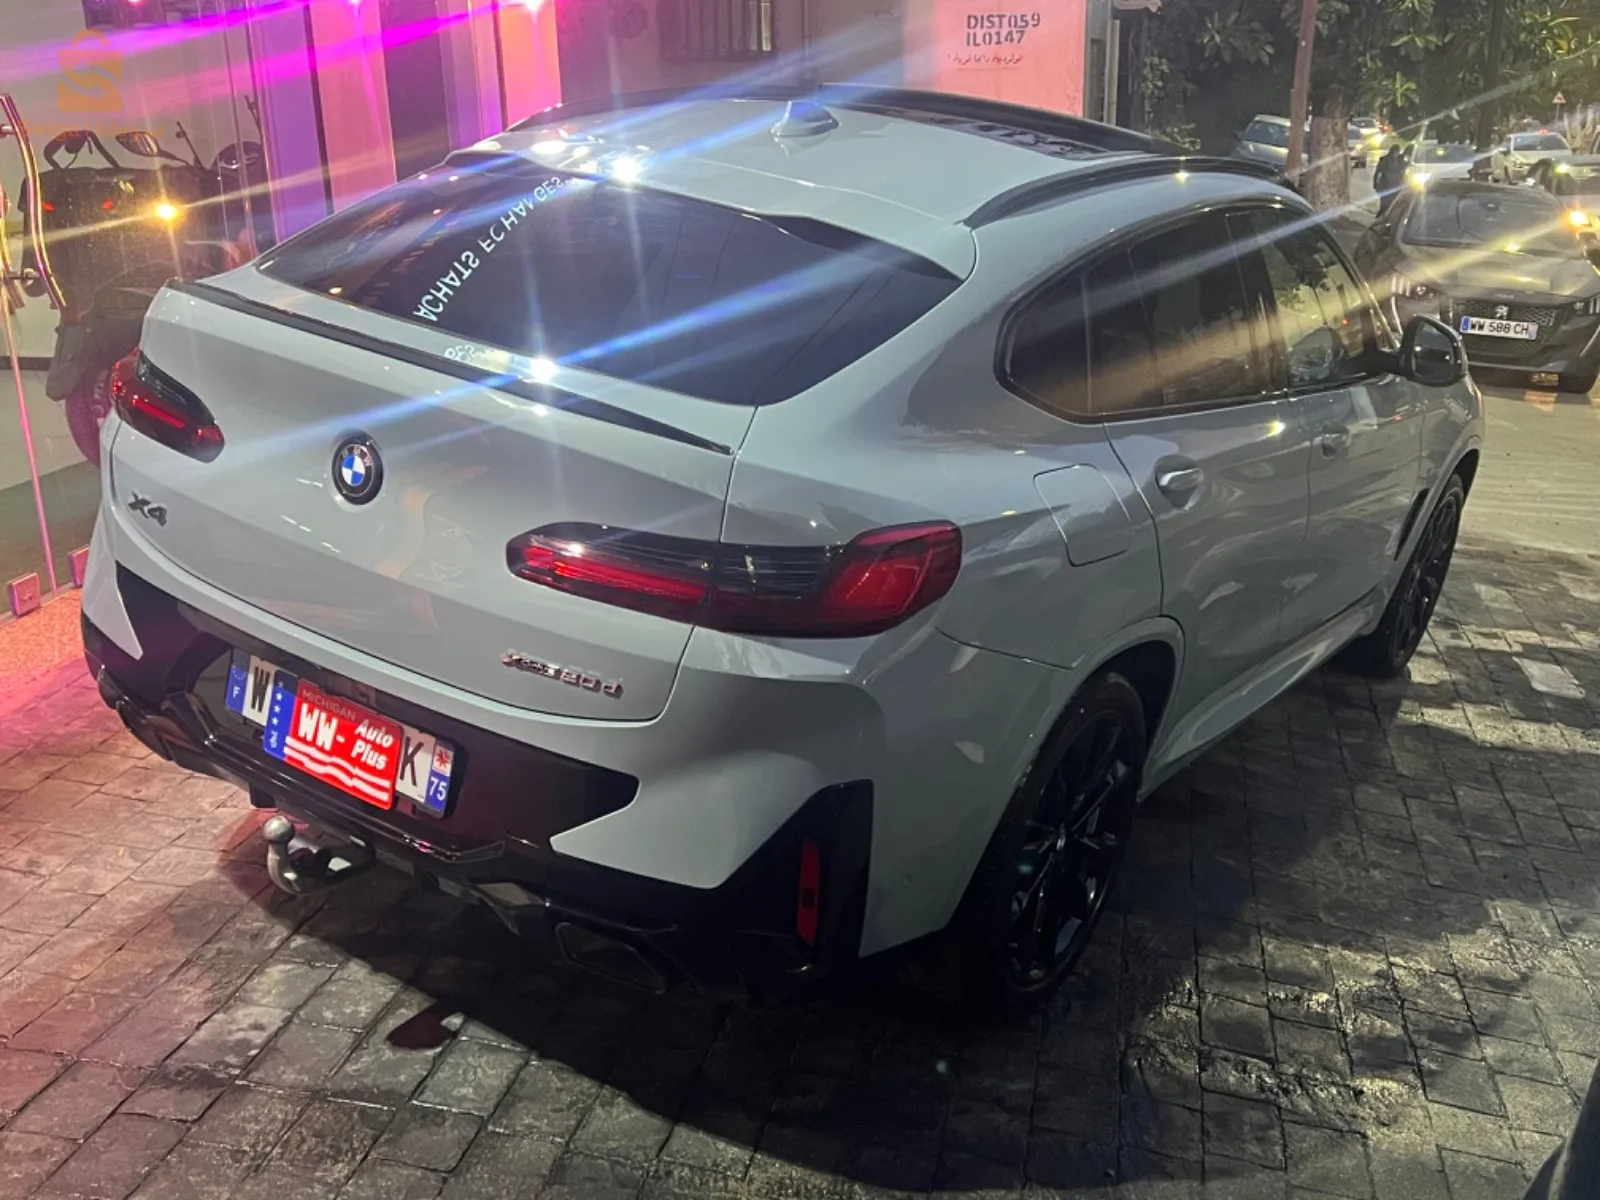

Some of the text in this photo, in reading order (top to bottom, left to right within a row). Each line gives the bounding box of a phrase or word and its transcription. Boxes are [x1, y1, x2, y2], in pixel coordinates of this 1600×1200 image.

[1470, 319, 1486, 332] WW
[1513, 323, 1529, 336] CH
[128, 490, 168, 528] X4
[302, 688, 356, 722] MICHIGAN
[355, 718, 394, 748] Auto
[351, 740, 389, 771] Plus
[399, 736, 425, 788] K
[429, 776, 448, 801] 75
